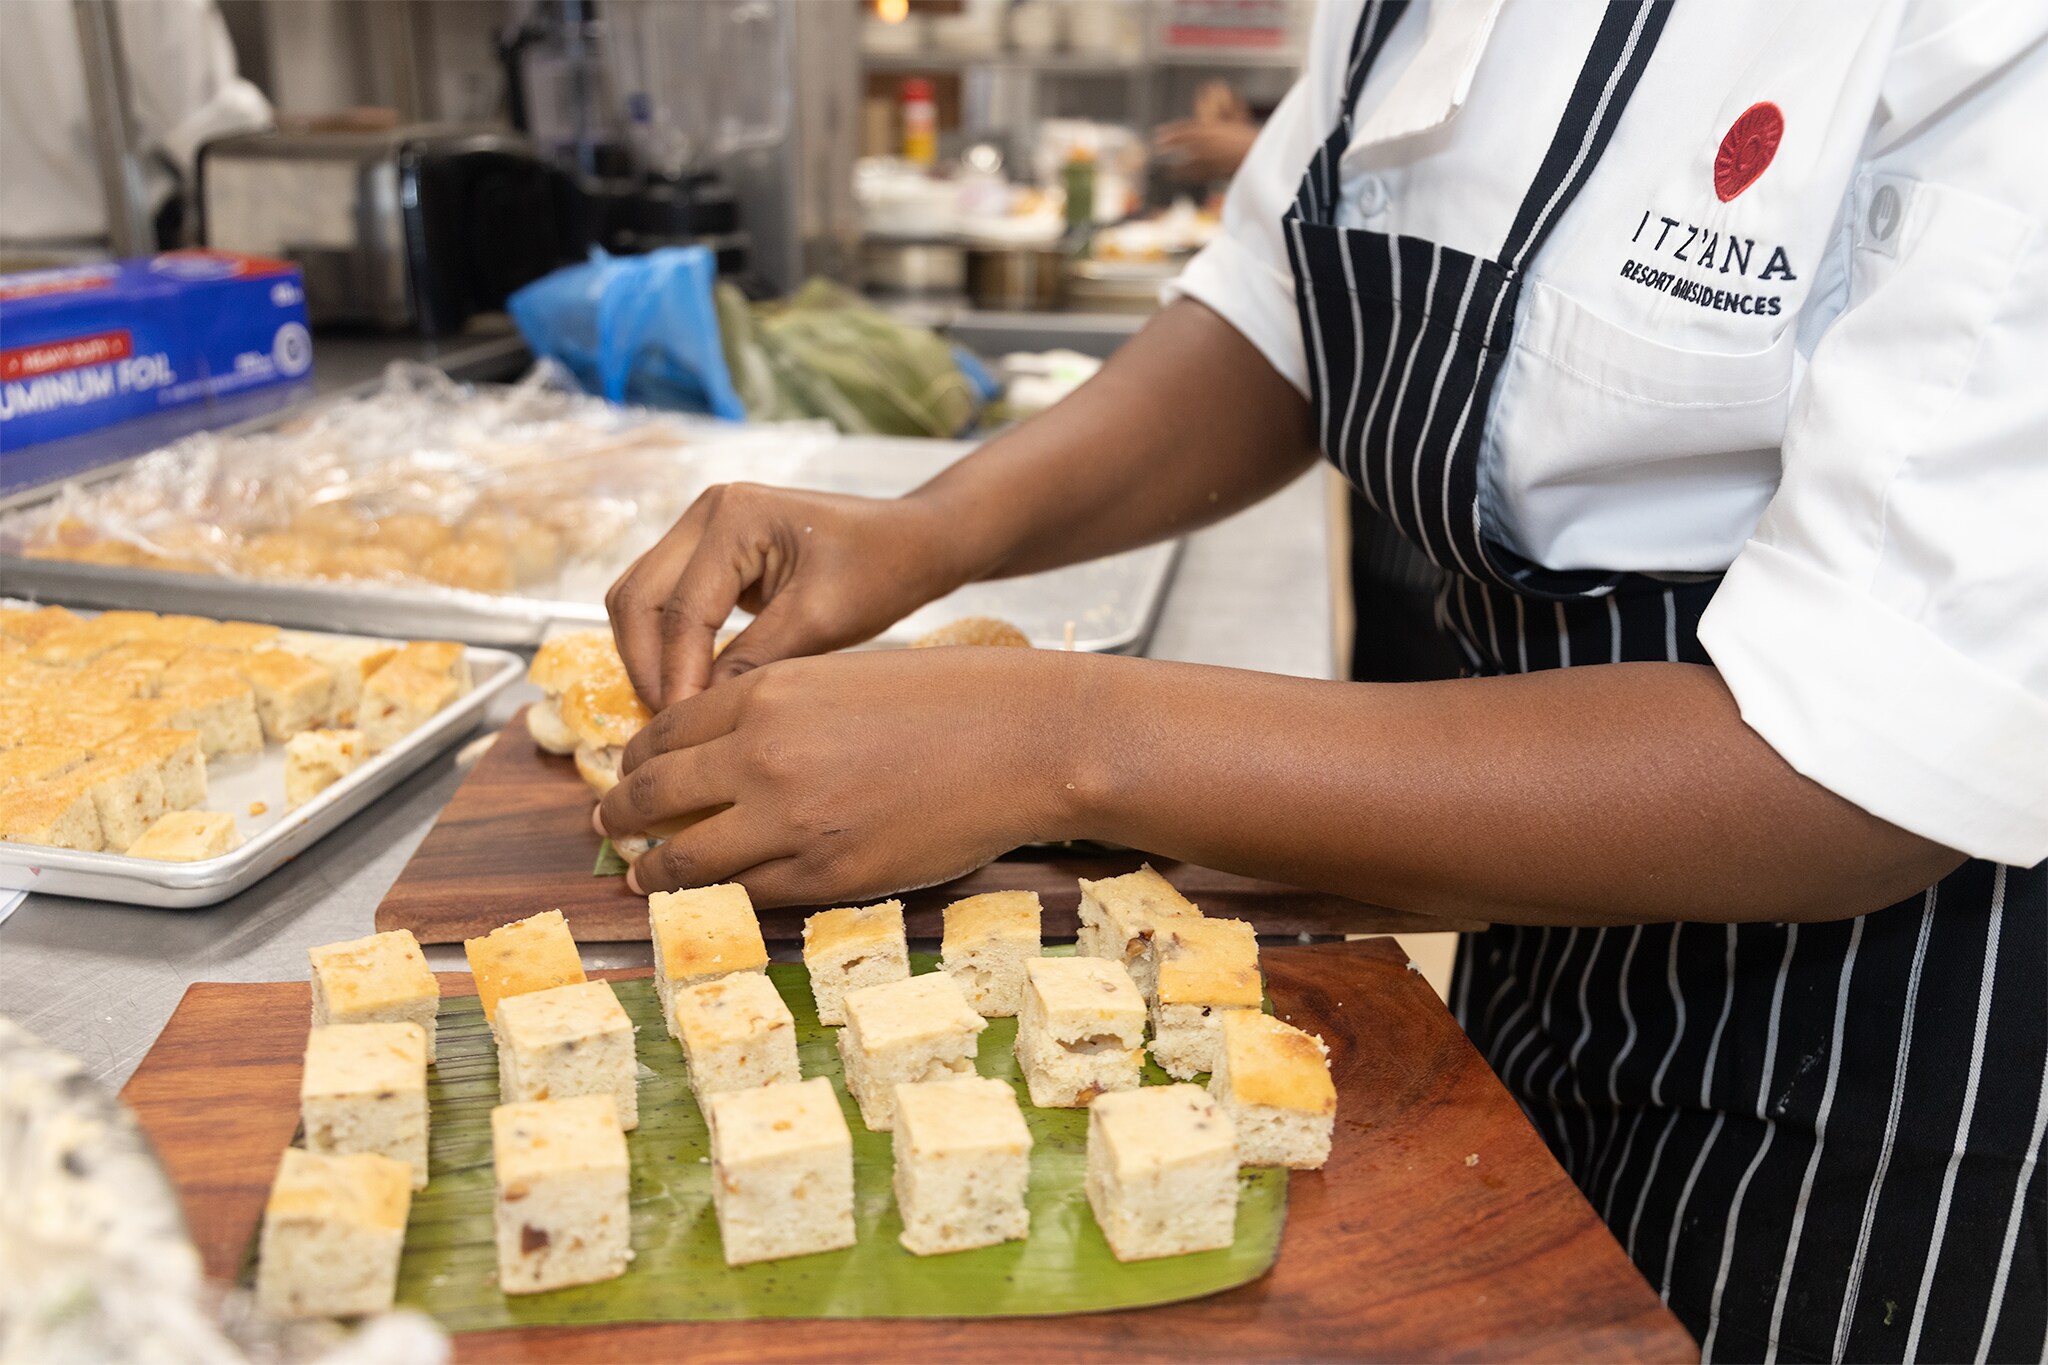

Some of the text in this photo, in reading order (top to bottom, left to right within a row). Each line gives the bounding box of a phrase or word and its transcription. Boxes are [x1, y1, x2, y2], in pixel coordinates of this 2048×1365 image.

[1631, 210, 1797, 281] ITZ'ANA
[1620, 259, 1675, 293] RESORT
[22, 338, 110, 374] HEAVY DUTY
[117, 352, 178, 394] FOIL
